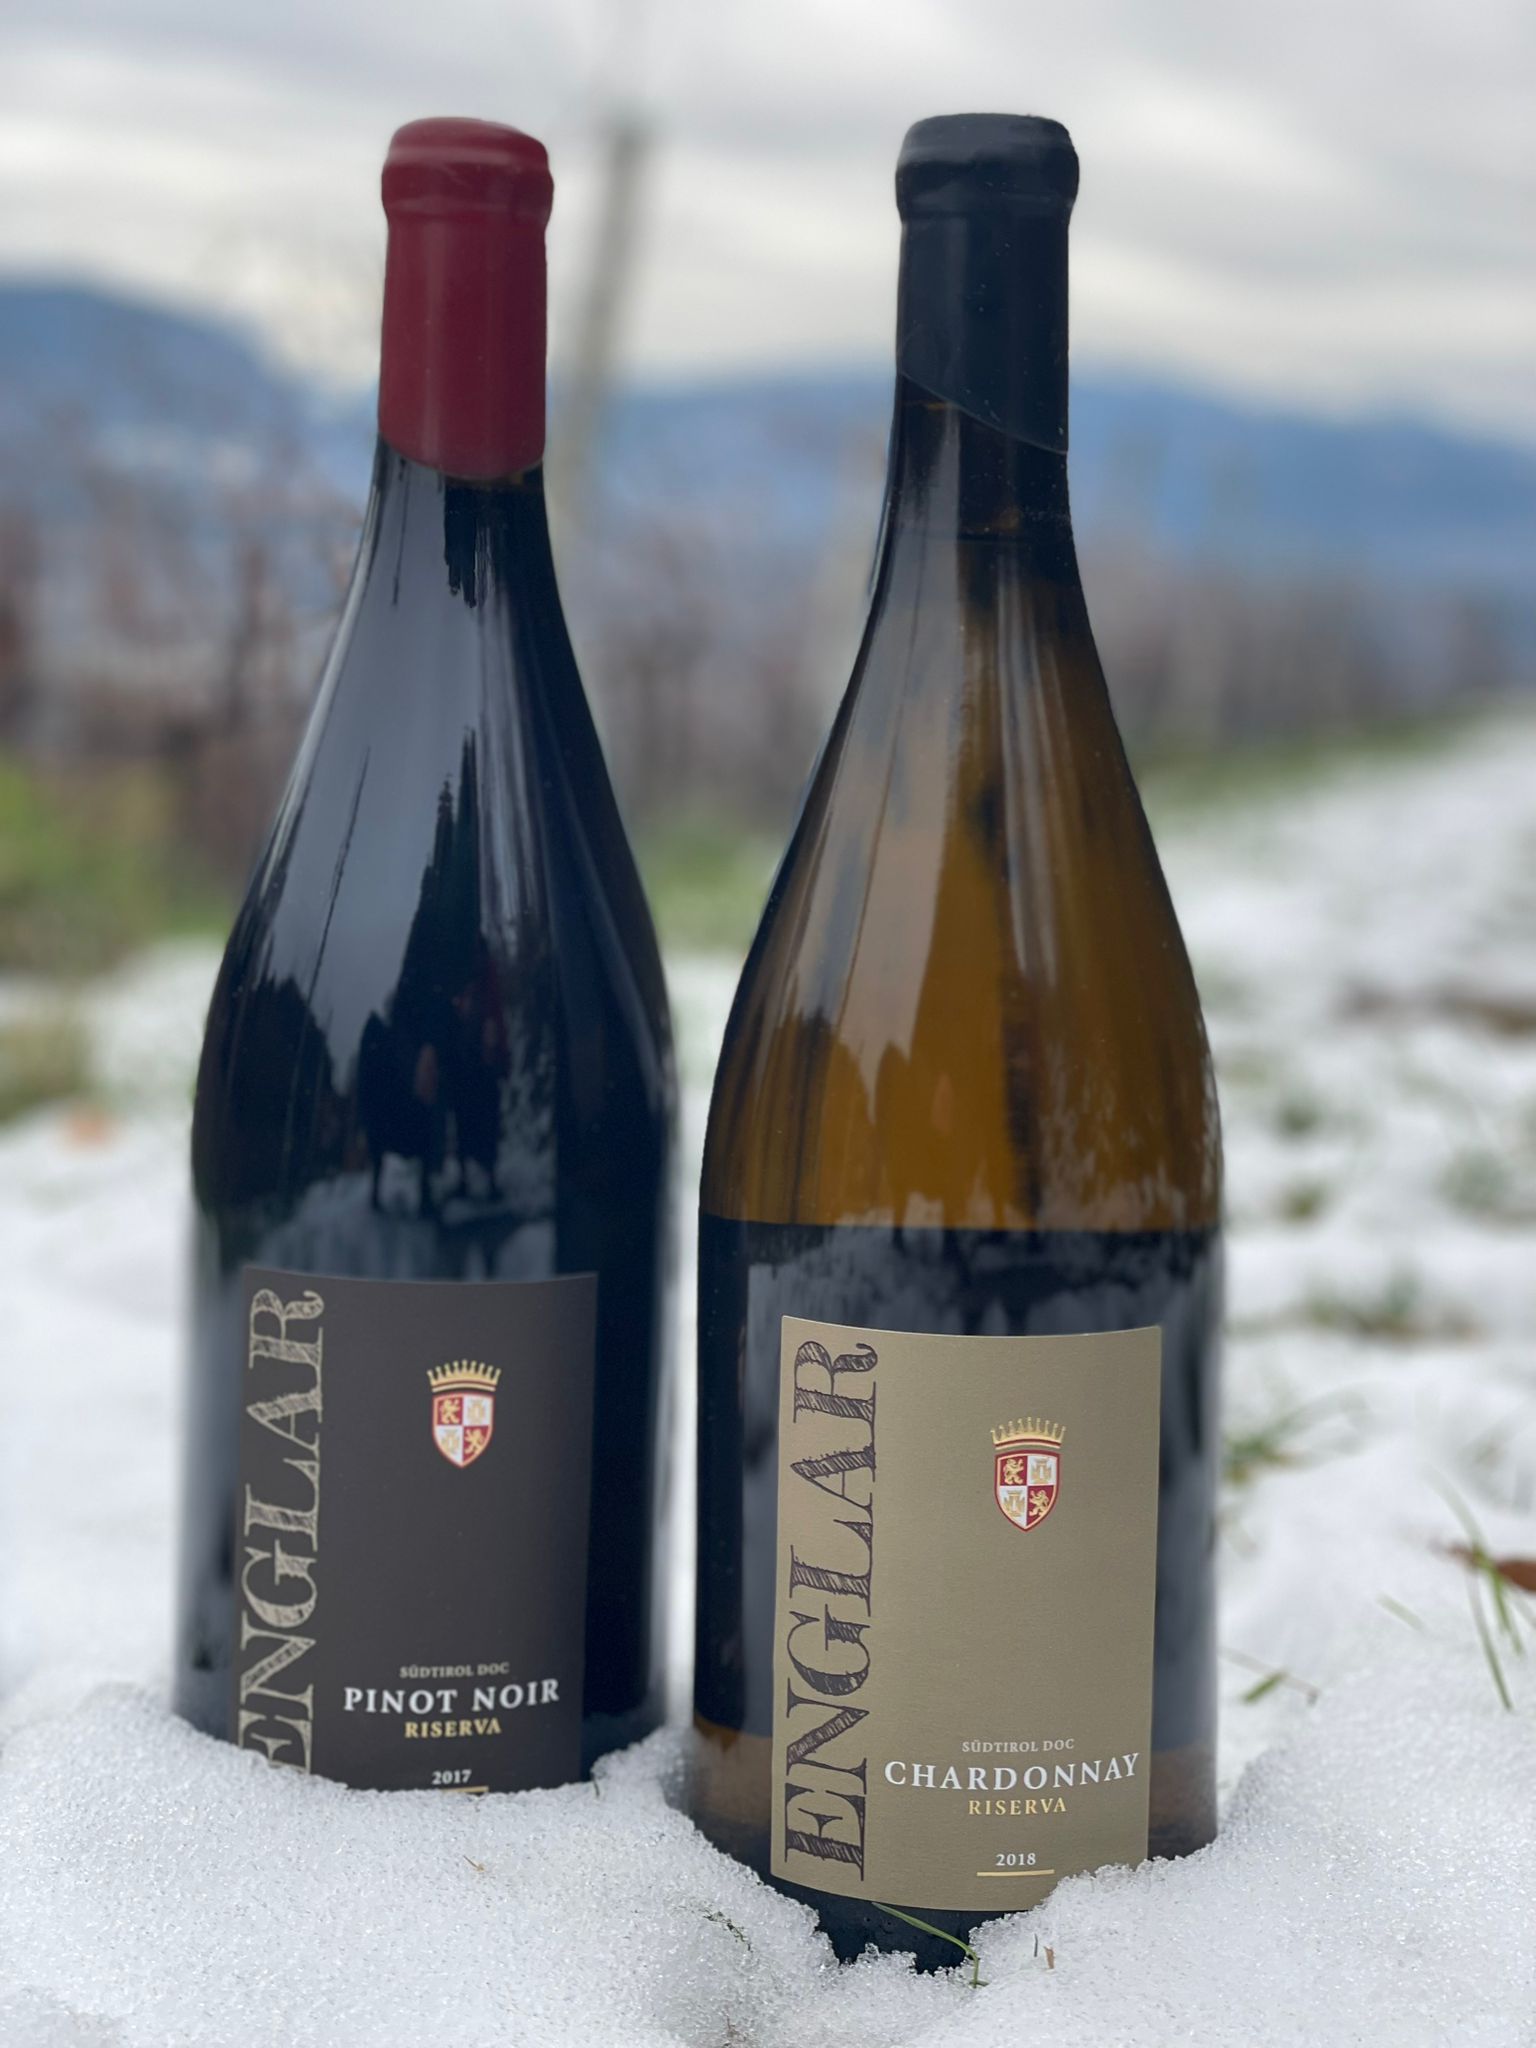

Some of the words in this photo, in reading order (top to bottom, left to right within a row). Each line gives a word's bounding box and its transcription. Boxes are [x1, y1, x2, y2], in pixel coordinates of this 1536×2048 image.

[236, 1287, 325, 1776] ENGLAR
[784, 1339, 879, 1882] ENGLAR
[399, 1664, 474, 1679] SÜDTIROL
[477, 1662, 510, 1676] DOC
[343, 1686, 457, 1715] PINOT
[471, 1677, 561, 1712] NOIR
[404, 1717, 502, 1739] RISERVA
[962, 1738, 1039, 1754] SÜDTIROL
[1042, 1737, 1076, 1752] DOC
[431, 1768, 472, 1785] 2017
[884, 1752, 1141, 1792] CHARDONNAY
[967, 1797, 1068, 1817] RISERVA
[994, 1852, 1037, 1867] 2018
